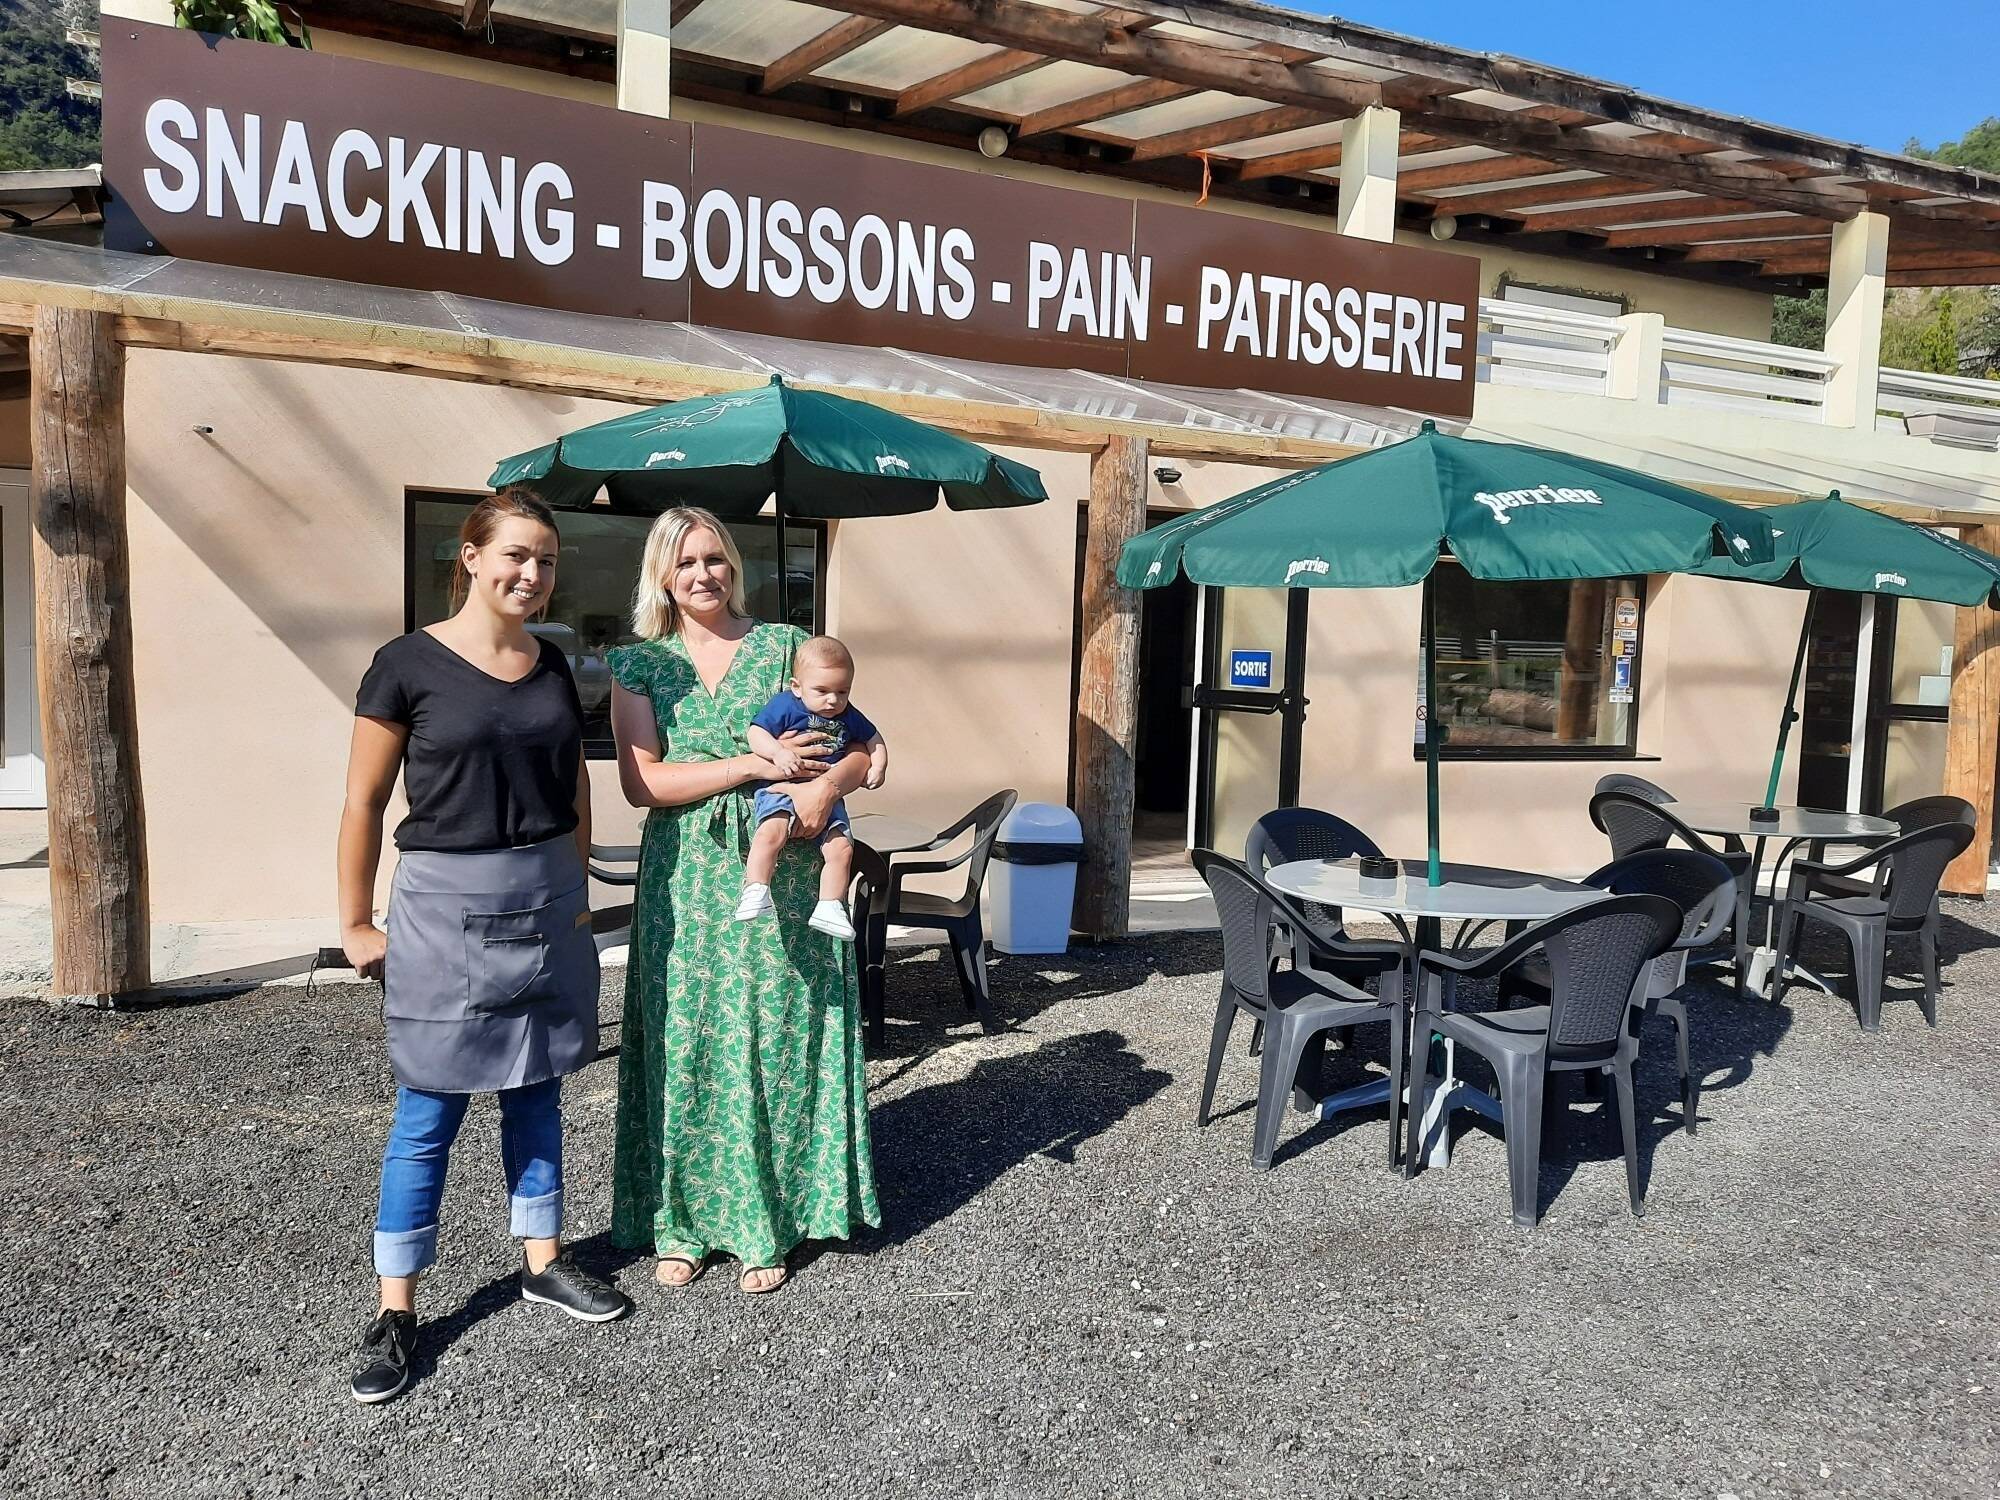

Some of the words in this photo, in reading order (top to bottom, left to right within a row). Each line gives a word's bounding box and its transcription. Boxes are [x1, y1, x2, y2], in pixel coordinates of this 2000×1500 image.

[143, 98, 574, 267] SNACKING
[641, 179, 976, 321] BOISSONS
[1027, 240, 1152, 342] PAIN
[1197, 265, 1466, 382] PATISSERIE
[1234, 659, 1268, 677] SORTIE
